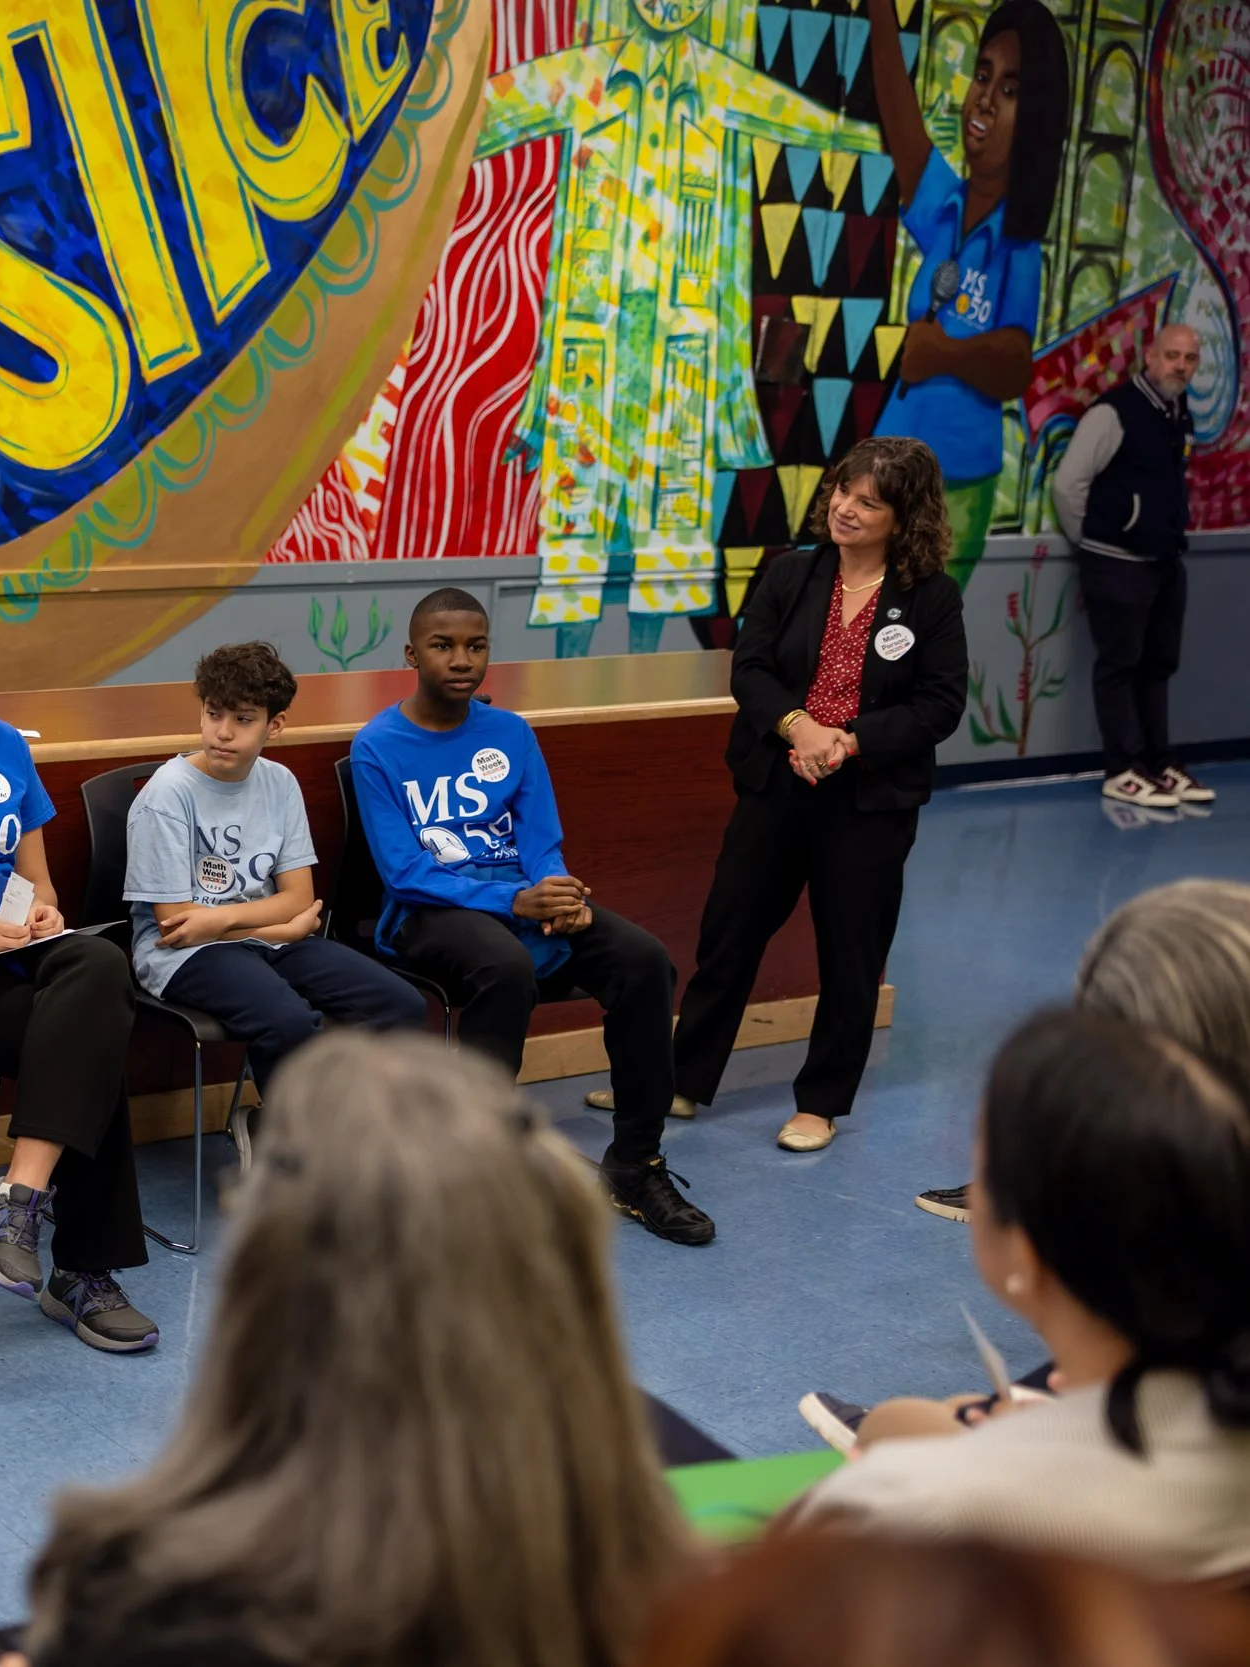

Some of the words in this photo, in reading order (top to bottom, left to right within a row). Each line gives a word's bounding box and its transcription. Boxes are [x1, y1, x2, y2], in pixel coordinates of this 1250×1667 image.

[960, 267, 988, 298] MS
[967, 296, 992, 323] 50
[882, 632, 902, 643] Math
[476, 753, 499, 766] Math
[479, 759, 504, 772] Week
[403, 772, 488, 826] MS
[202, 860, 227, 871] Math
[202, 868, 227, 879] Week
